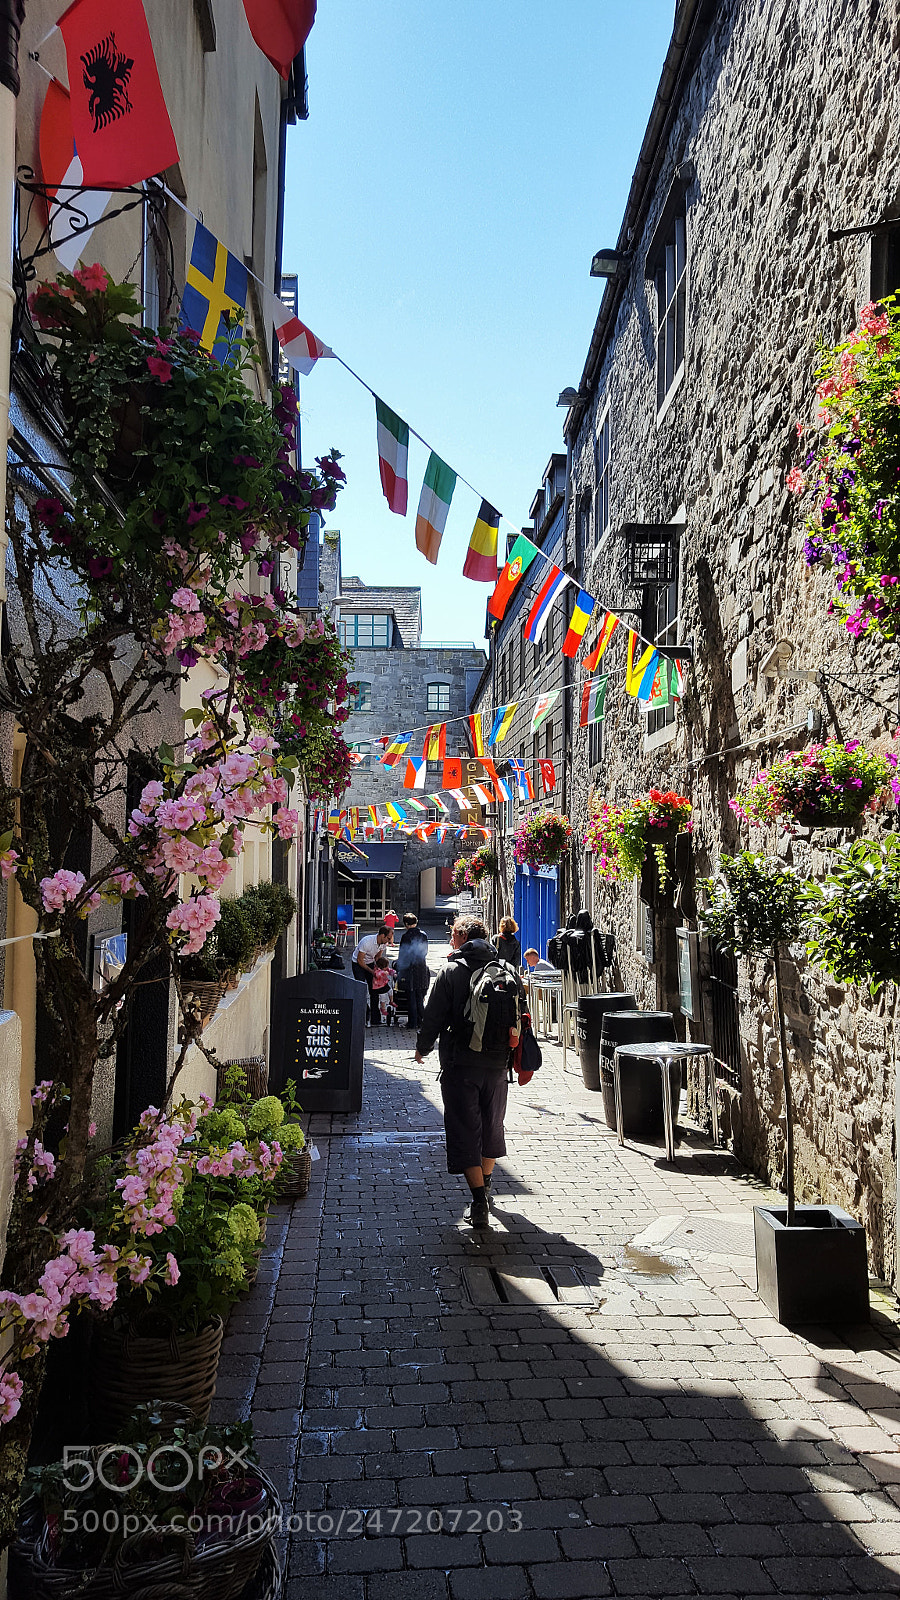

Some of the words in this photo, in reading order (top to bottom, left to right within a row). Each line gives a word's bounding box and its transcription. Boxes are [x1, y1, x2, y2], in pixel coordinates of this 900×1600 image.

[308, 1025, 331, 1035] GIN
[306, 1036, 331, 1046] THIS
[305, 1047, 331, 1057] WAY
